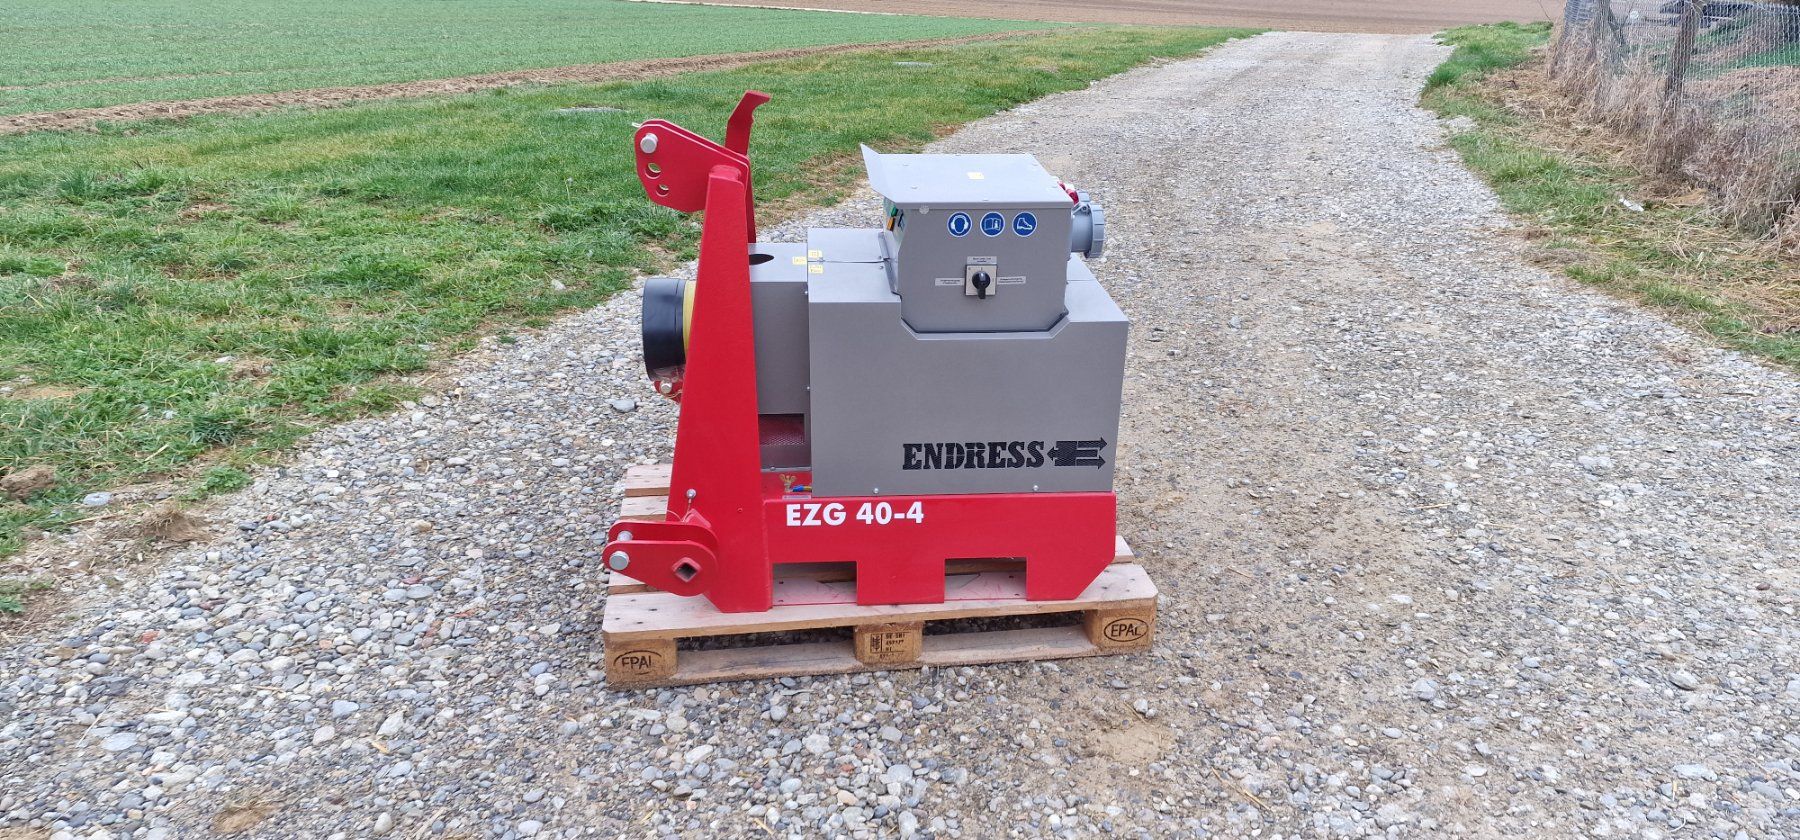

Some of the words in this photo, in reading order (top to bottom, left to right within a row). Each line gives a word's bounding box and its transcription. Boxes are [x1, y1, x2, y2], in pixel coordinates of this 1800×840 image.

[902, 441, 1044, 470] ENDRESS
[786, 502, 847, 526] EZG
[856, 501, 925, 525] 40-4
[1110, 623, 1141, 637] EPAL
